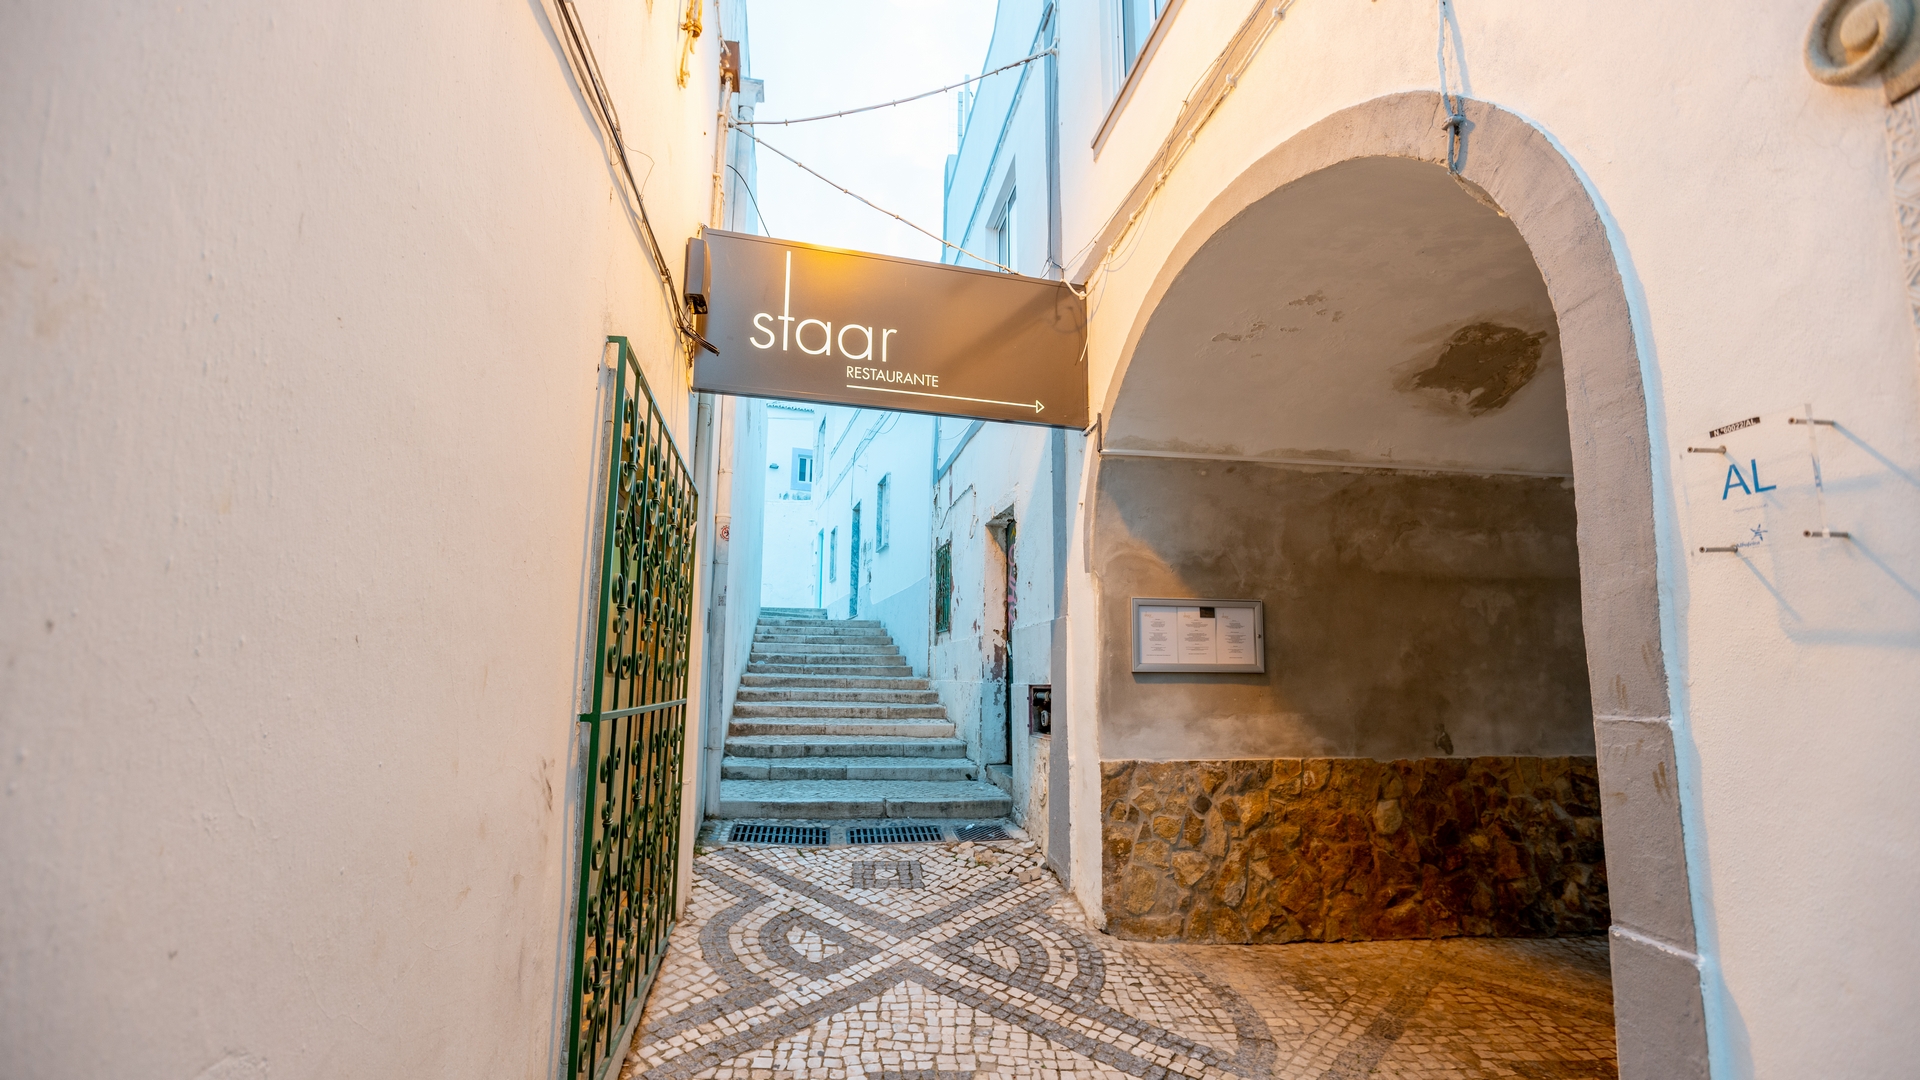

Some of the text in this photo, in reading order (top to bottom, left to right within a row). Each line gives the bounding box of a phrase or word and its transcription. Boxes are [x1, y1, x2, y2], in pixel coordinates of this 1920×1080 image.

[749, 251, 898, 362] staar
[846, 365, 939, 387] RESTAURANTE
[1722, 459, 1777, 500] AL
